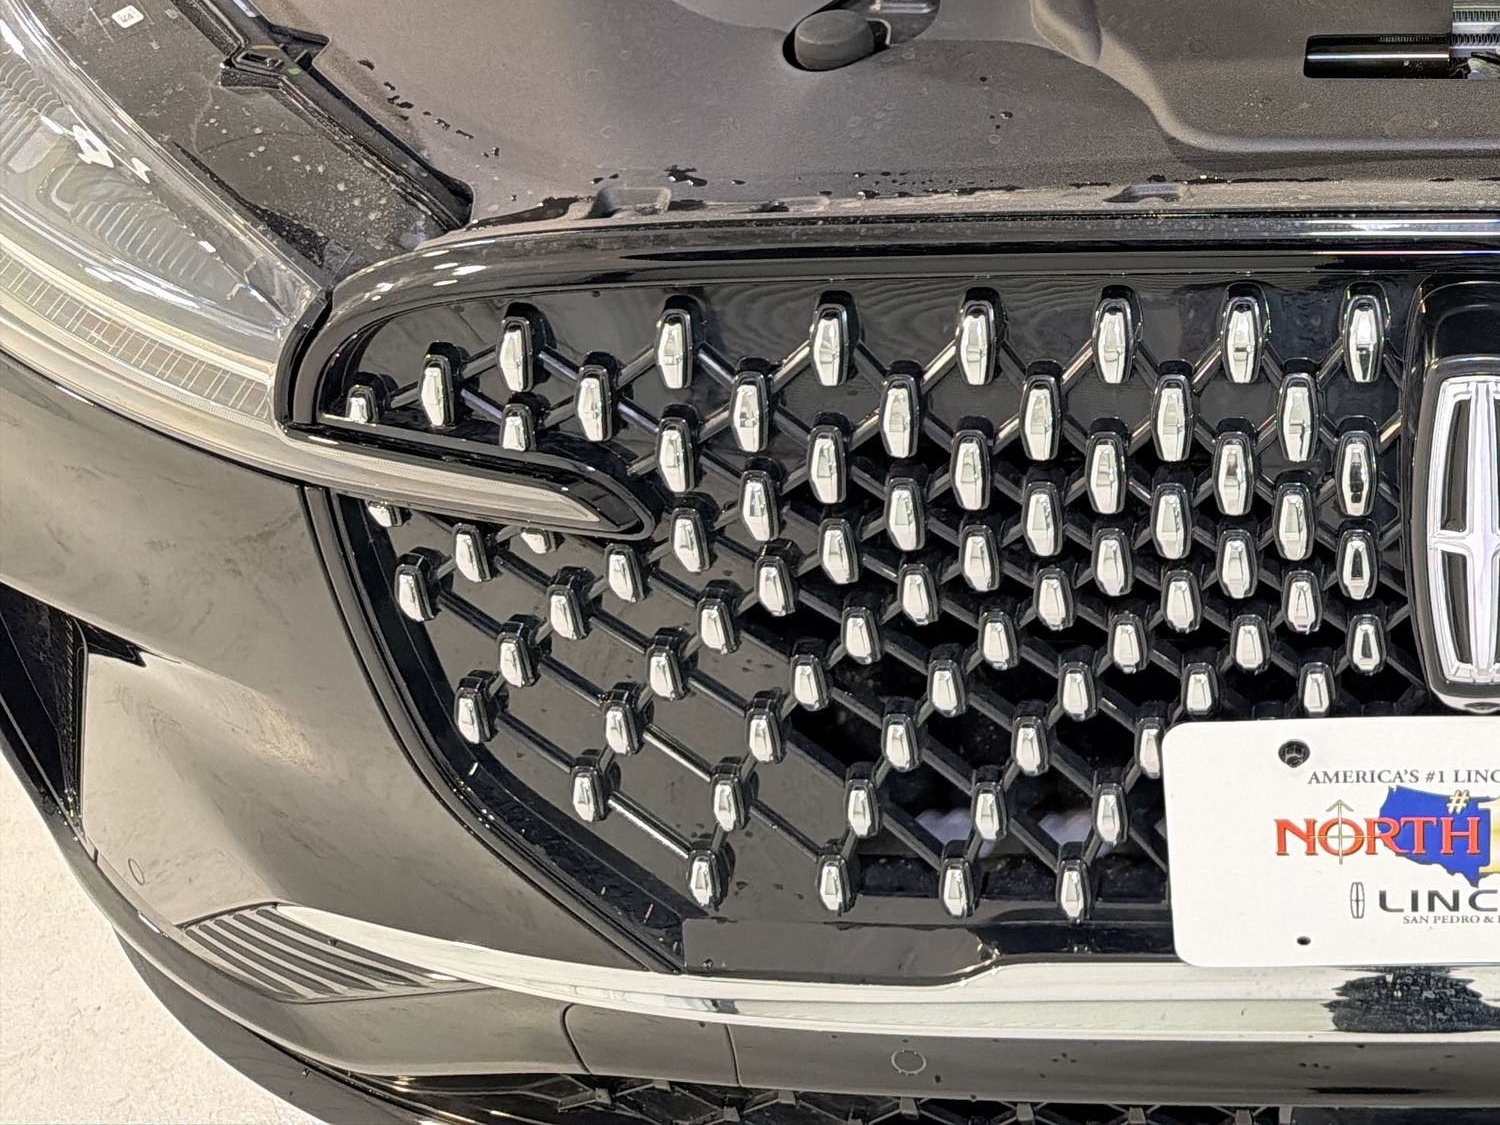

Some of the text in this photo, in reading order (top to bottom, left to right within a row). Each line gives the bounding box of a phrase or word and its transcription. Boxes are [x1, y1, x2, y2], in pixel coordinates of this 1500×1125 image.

[1307, 769, 1420, 785] AMERICA’S
[1425, 769, 1445, 784] #1
[1274, 816, 1481, 856] NORTH
[1403, 915, 1429, 925] SAN
[1433, 915, 1480, 924] PEDRO
[1483, 915, 1495, 924] &
